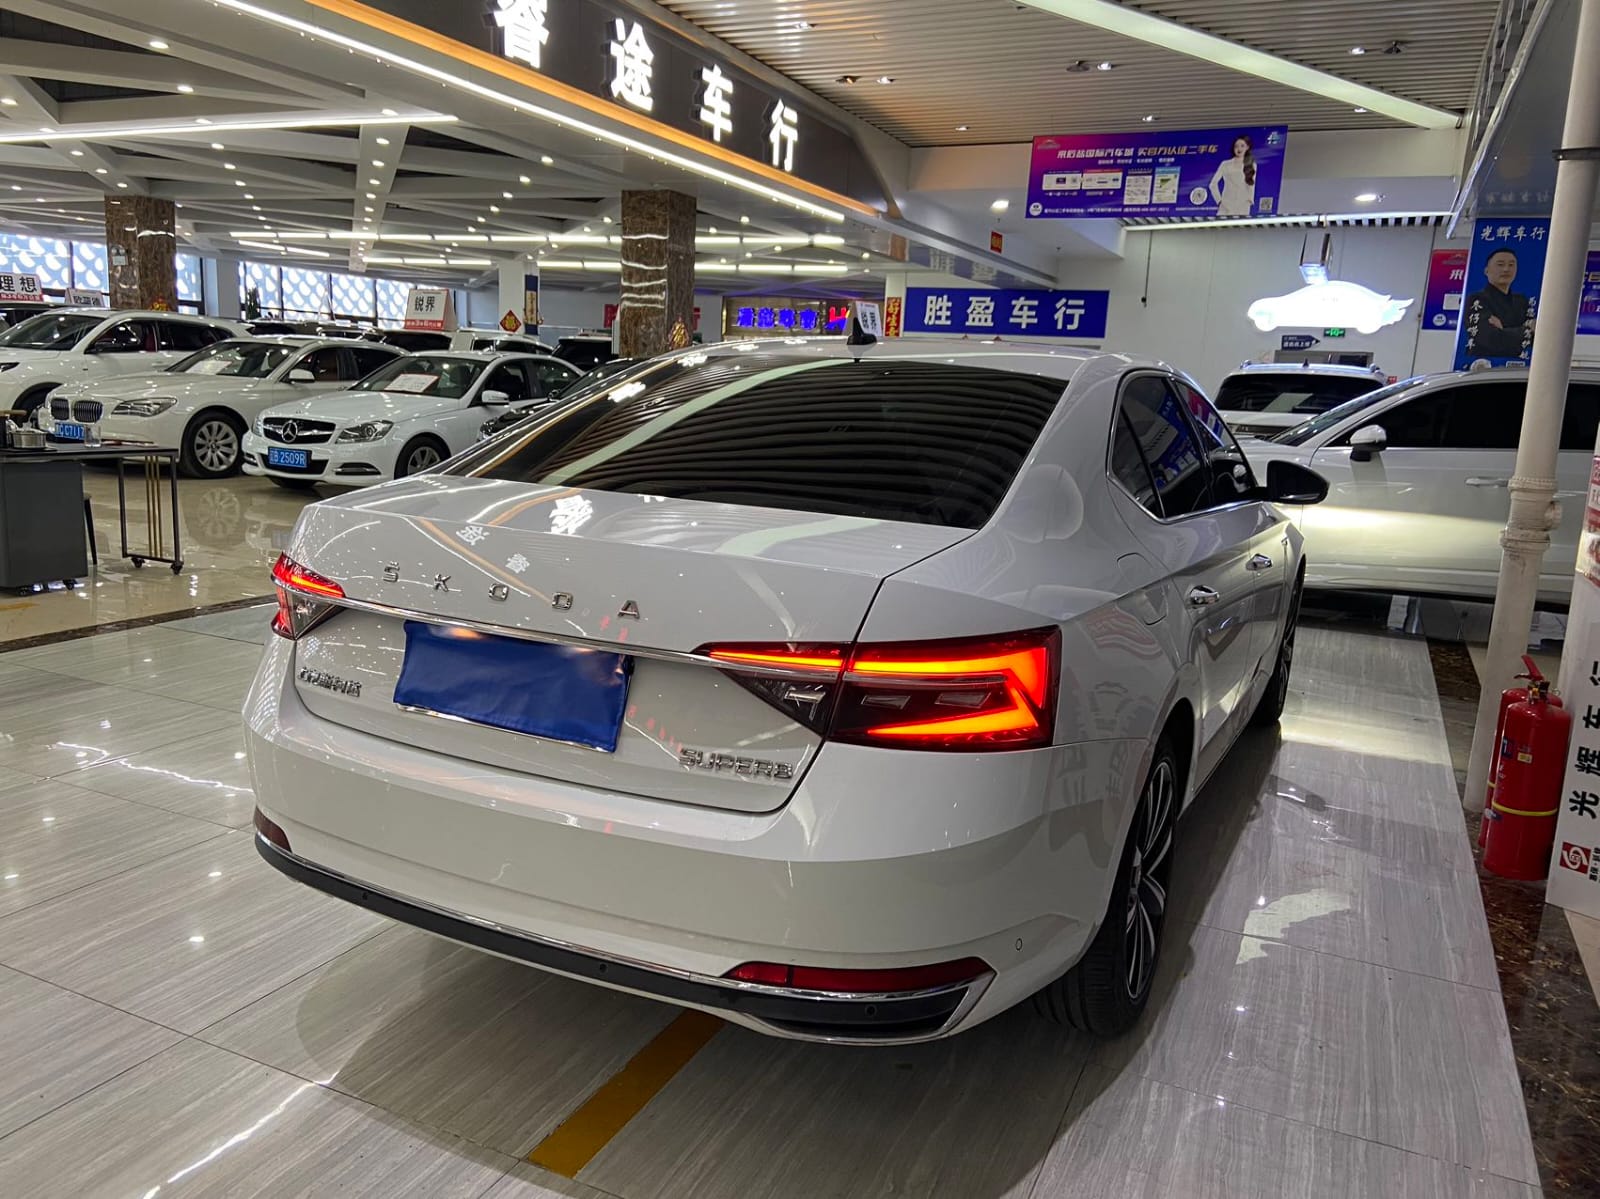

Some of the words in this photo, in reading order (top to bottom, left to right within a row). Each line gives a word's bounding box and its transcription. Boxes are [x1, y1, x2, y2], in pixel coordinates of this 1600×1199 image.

[0, 275, 37, 292] 理想
[415, 296, 435, 312] 锐界
[924, 294, 1085, 330] 胜盈车行
[679, 748, 793, 779] SUPERB
